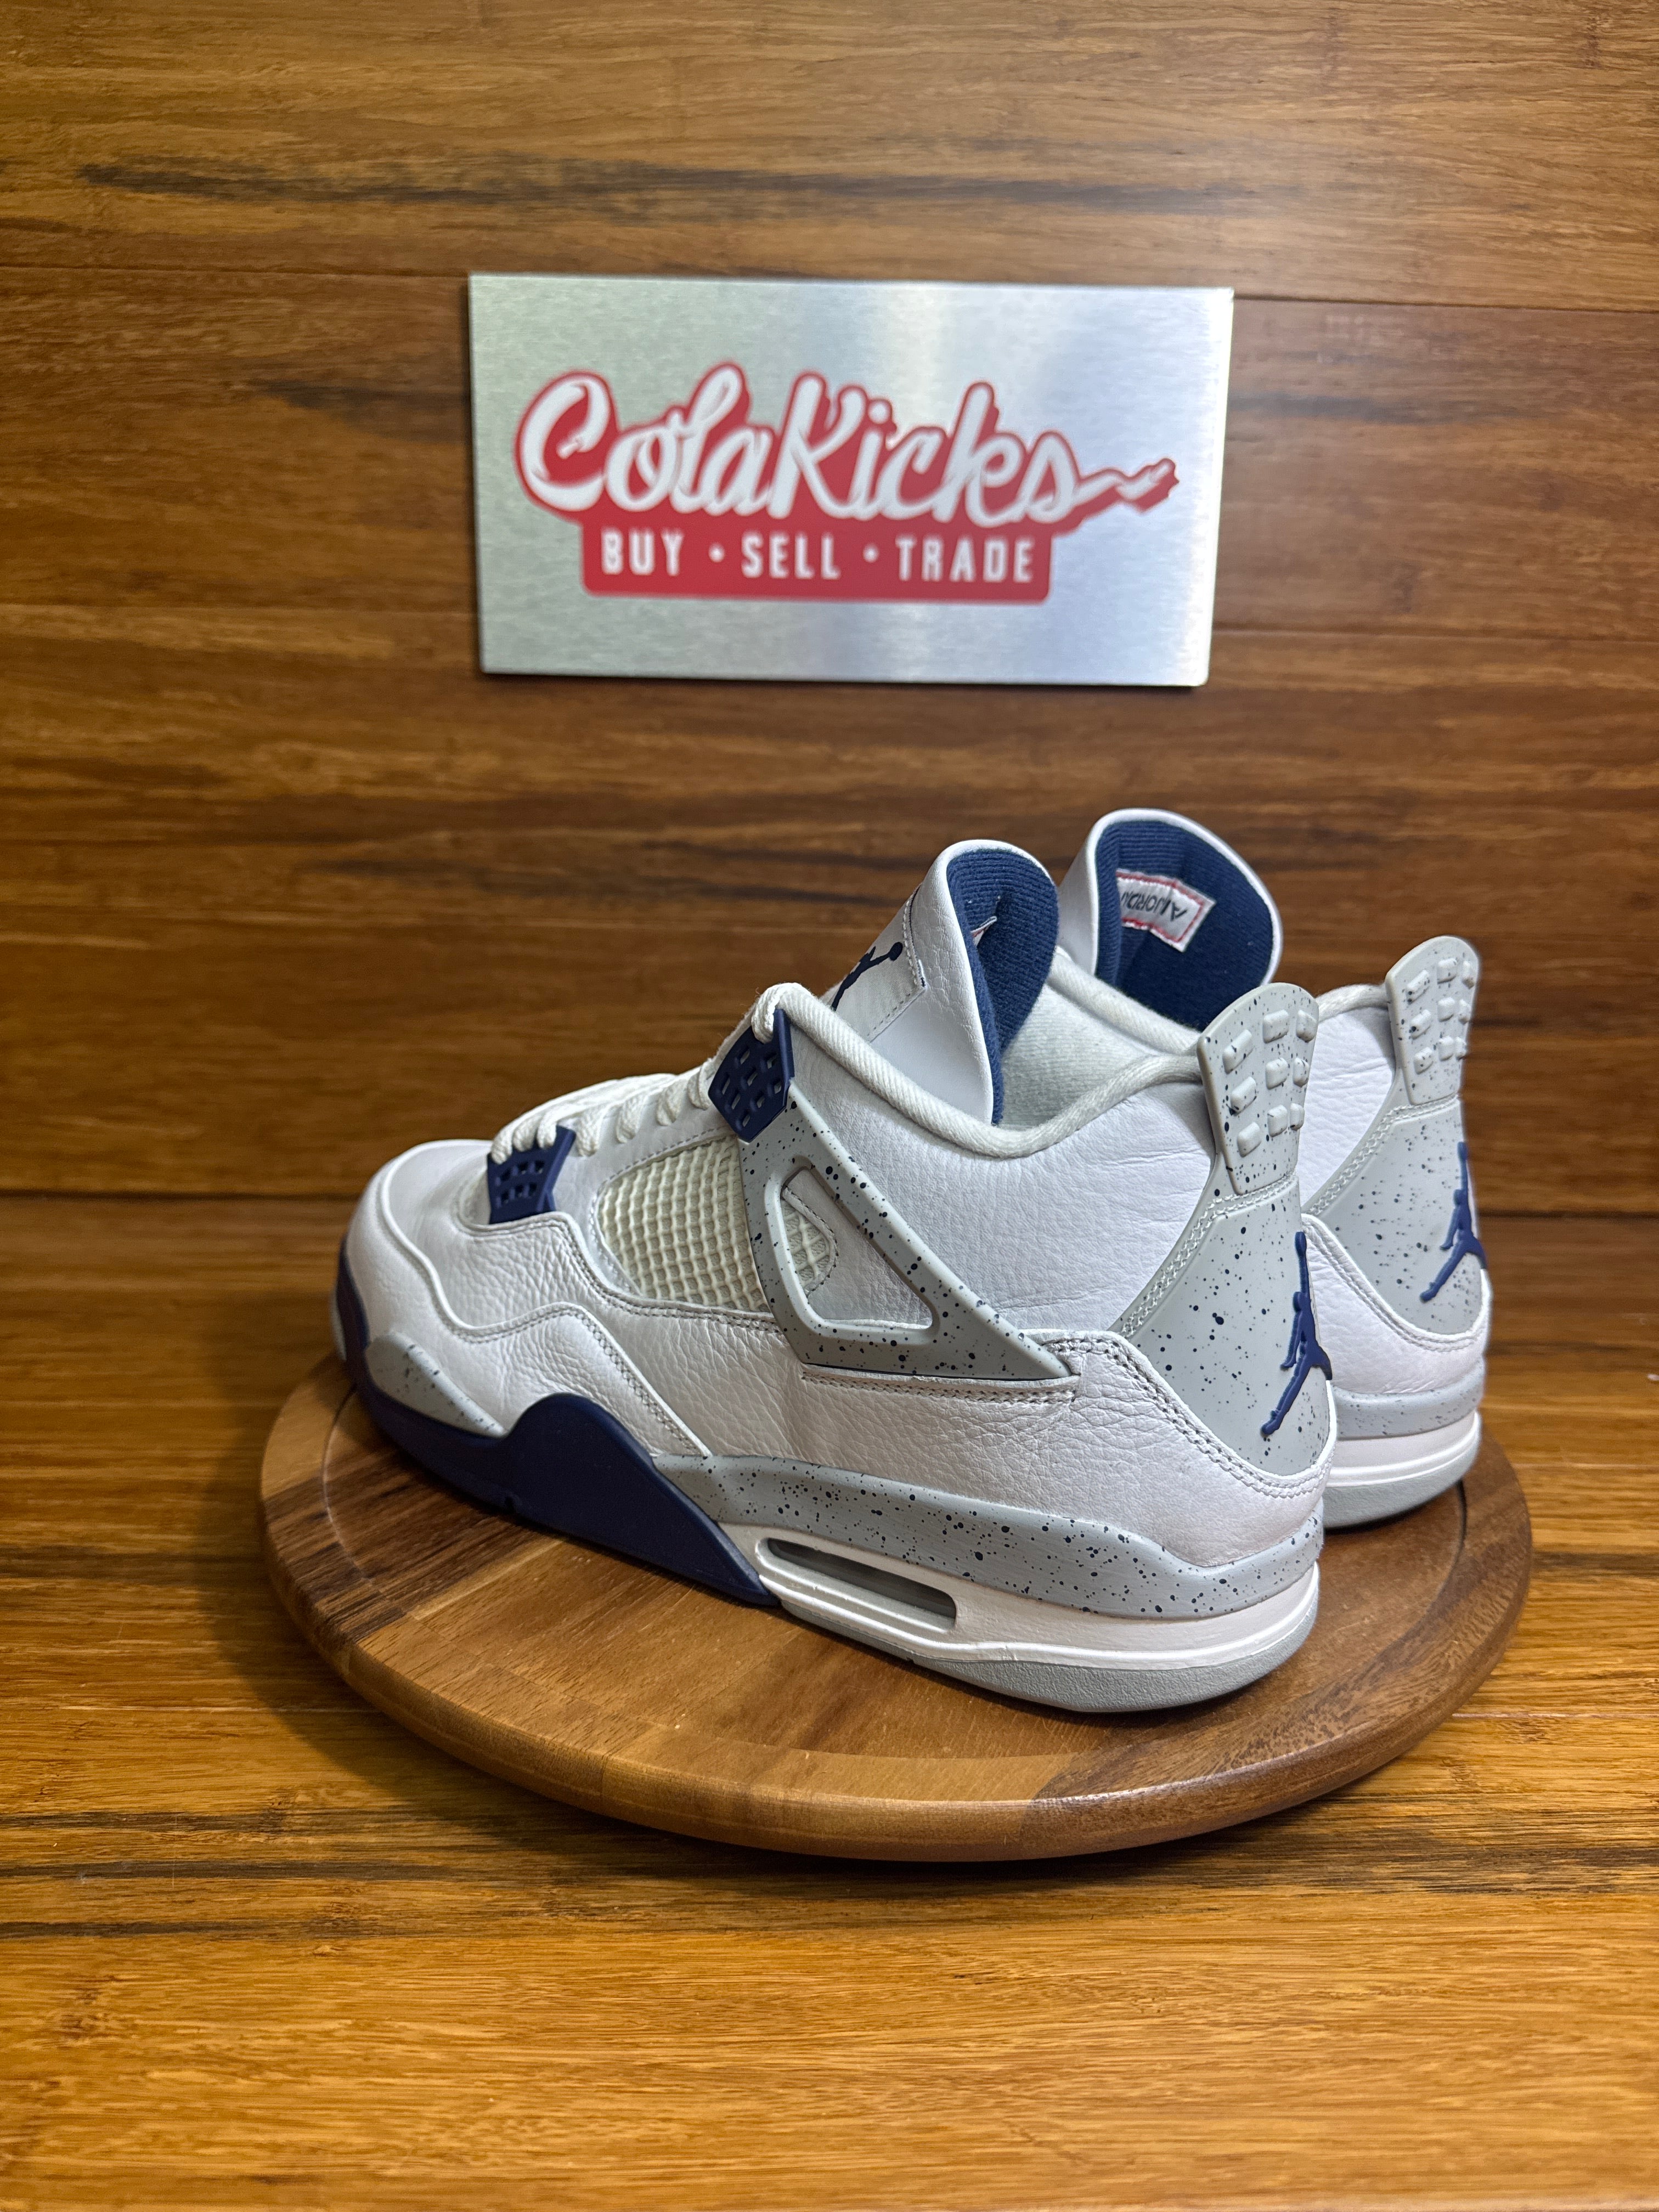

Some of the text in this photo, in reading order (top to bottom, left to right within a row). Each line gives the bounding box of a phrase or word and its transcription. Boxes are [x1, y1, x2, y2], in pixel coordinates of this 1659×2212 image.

[517, 361, 1175, 528] ColaKicks
[601, 527, 1034, 583] BUY SELL TRADE
